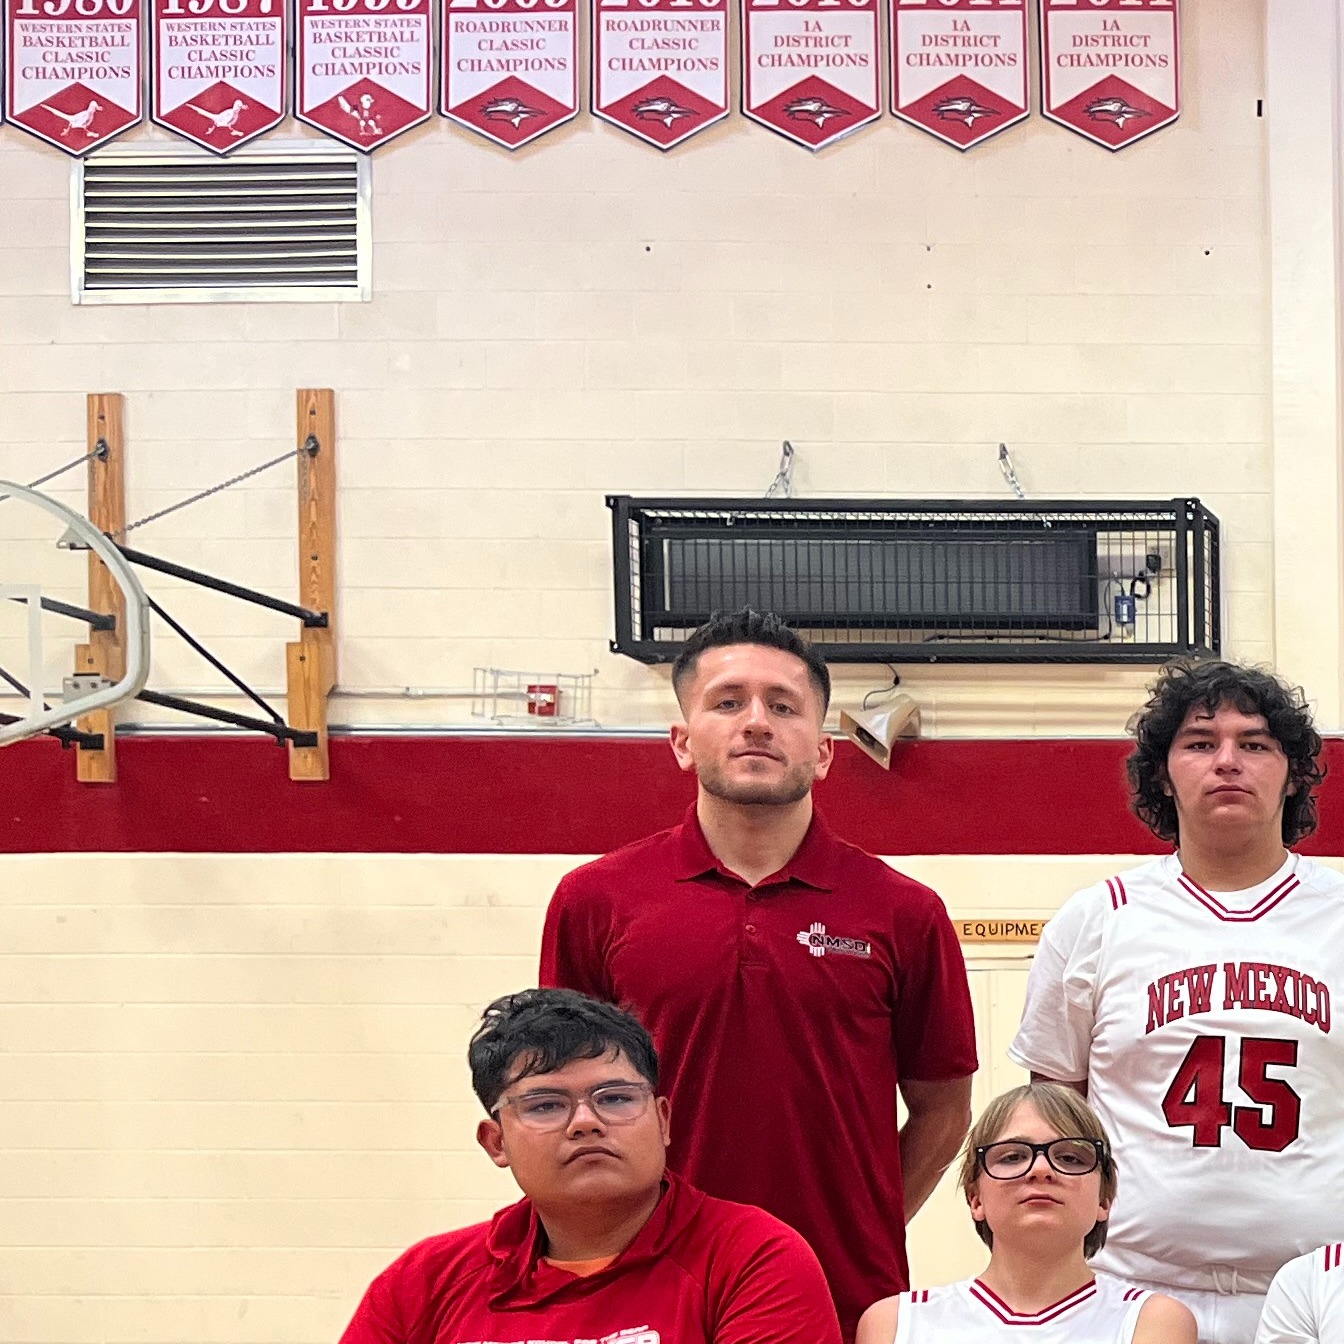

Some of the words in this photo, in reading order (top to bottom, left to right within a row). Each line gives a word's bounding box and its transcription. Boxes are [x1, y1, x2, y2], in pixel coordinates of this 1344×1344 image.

[21, 23, 82, 33] WESTERN
[86, 22, 132, 32] STATES
[166, 22, 226, 32] WESTERN
[230, 22, 276, 31] STATES
[310, 19, 371, 29] WESTERN
[374, 18, 421, 28] STATES
[455, 21, 569, 33] ROADRUNNER
[606, 20, 721, 32] ROADRUNNER
[23, 36, 130, 48] BASKETBALL
[169, 35, 274, 47] BASKETBALL
[313, 31, 419, 44] BASKETBALL
[774, 35, 852, 48] DISTRICT
[922, 35, 1001, 47] DISTRICT
[1072, 35, 1150, 47] DISTRICT
[478, 39, 545, 50] CLASSIC
[629, 38, 698, 50] CLASSIC
[42, 51, 110, 63] CLASSIC
[187, 50, 255, 62] CLASSIC
[331, 47, 400, 58] CLASSIC
[457, 58, 567, 72] CHAMPIONS
[608, 58, 719, 71] CHAMPIONS
[758, 54, 868, 67] CHAMPIONS
[906, 53, 1017, 67] CHAMPIONS
[1057, 53, 1168, 67] CHAMPIONS
[22, 66, 131, 80] CHAMPIONS
[168, 65, 275, 78] CHAMPIONS
[312, 62, 421, 76] CHAMPIONS
[964, 923, 1045, 937] EQUIPME
[1146, 964, 1217, 1035] NEW
[1223, 962, 1330, 1034] MEXICO
[1161, 1035, 1301, 1152] 45
